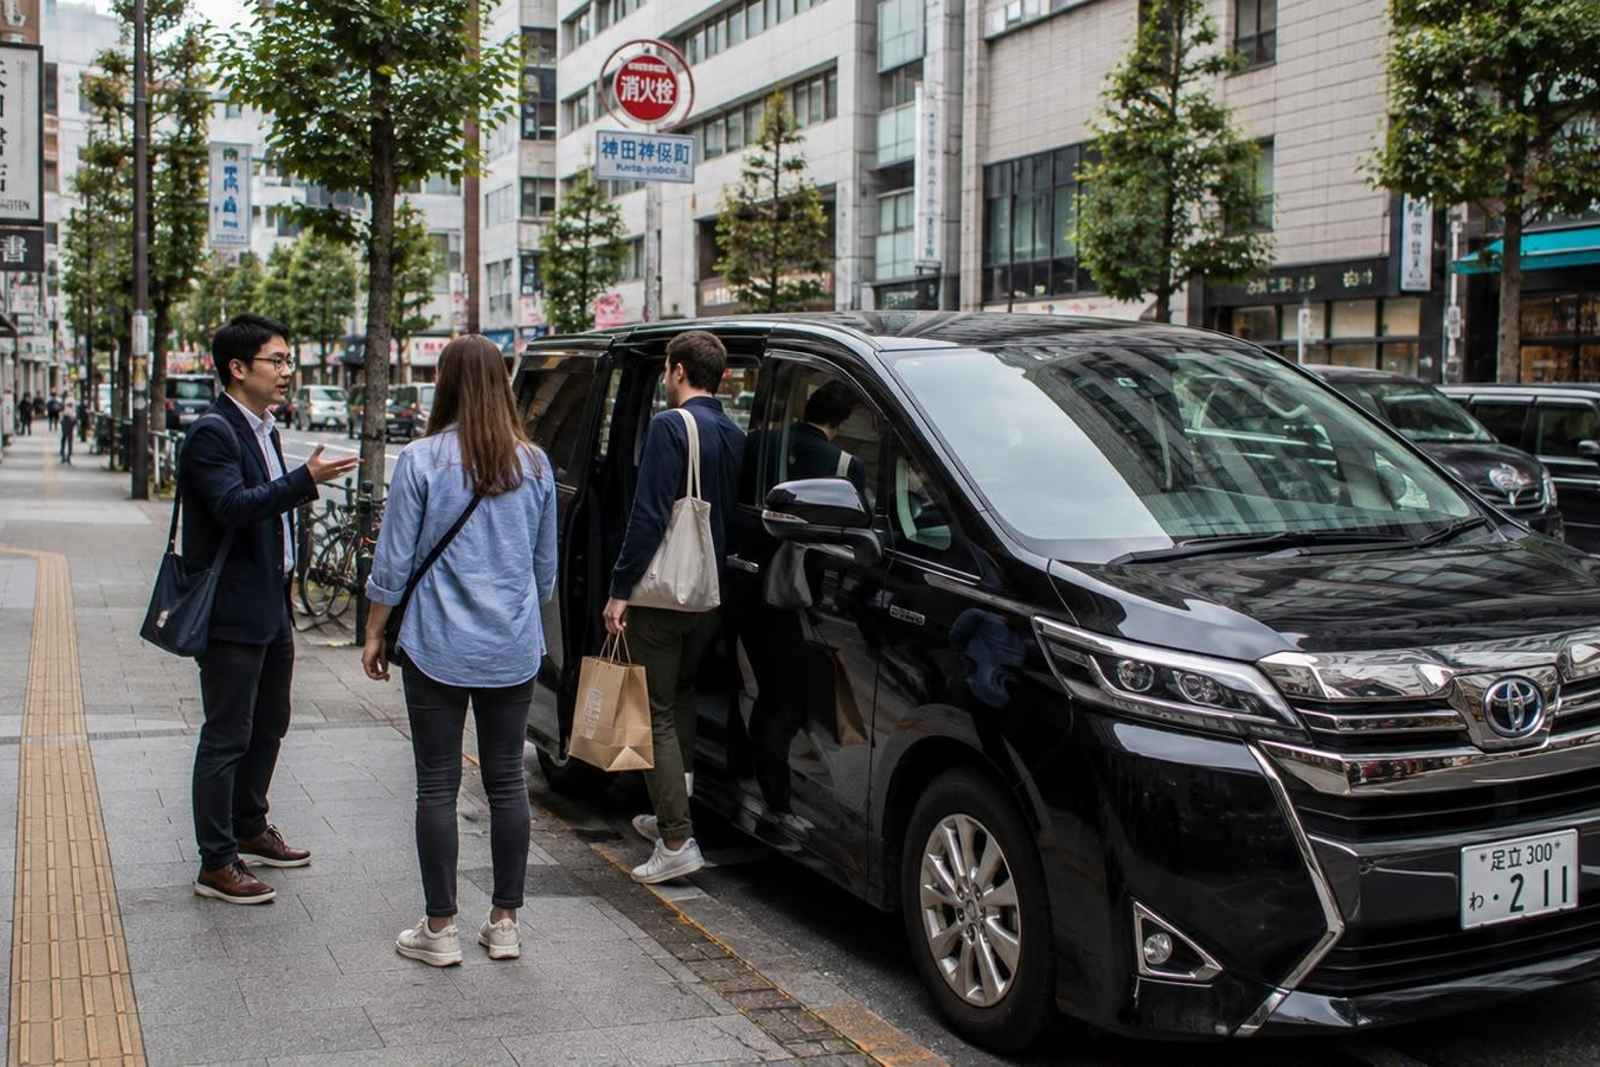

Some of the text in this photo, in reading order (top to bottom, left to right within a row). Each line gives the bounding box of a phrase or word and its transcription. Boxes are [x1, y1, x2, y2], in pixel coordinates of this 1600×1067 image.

[620, 75, 675, 104] 消火栓
[0, 234, 28, 263] 書
[1490, 842, 1553, 872] 足立 300
[1468, 891, 1485, 911] わ
